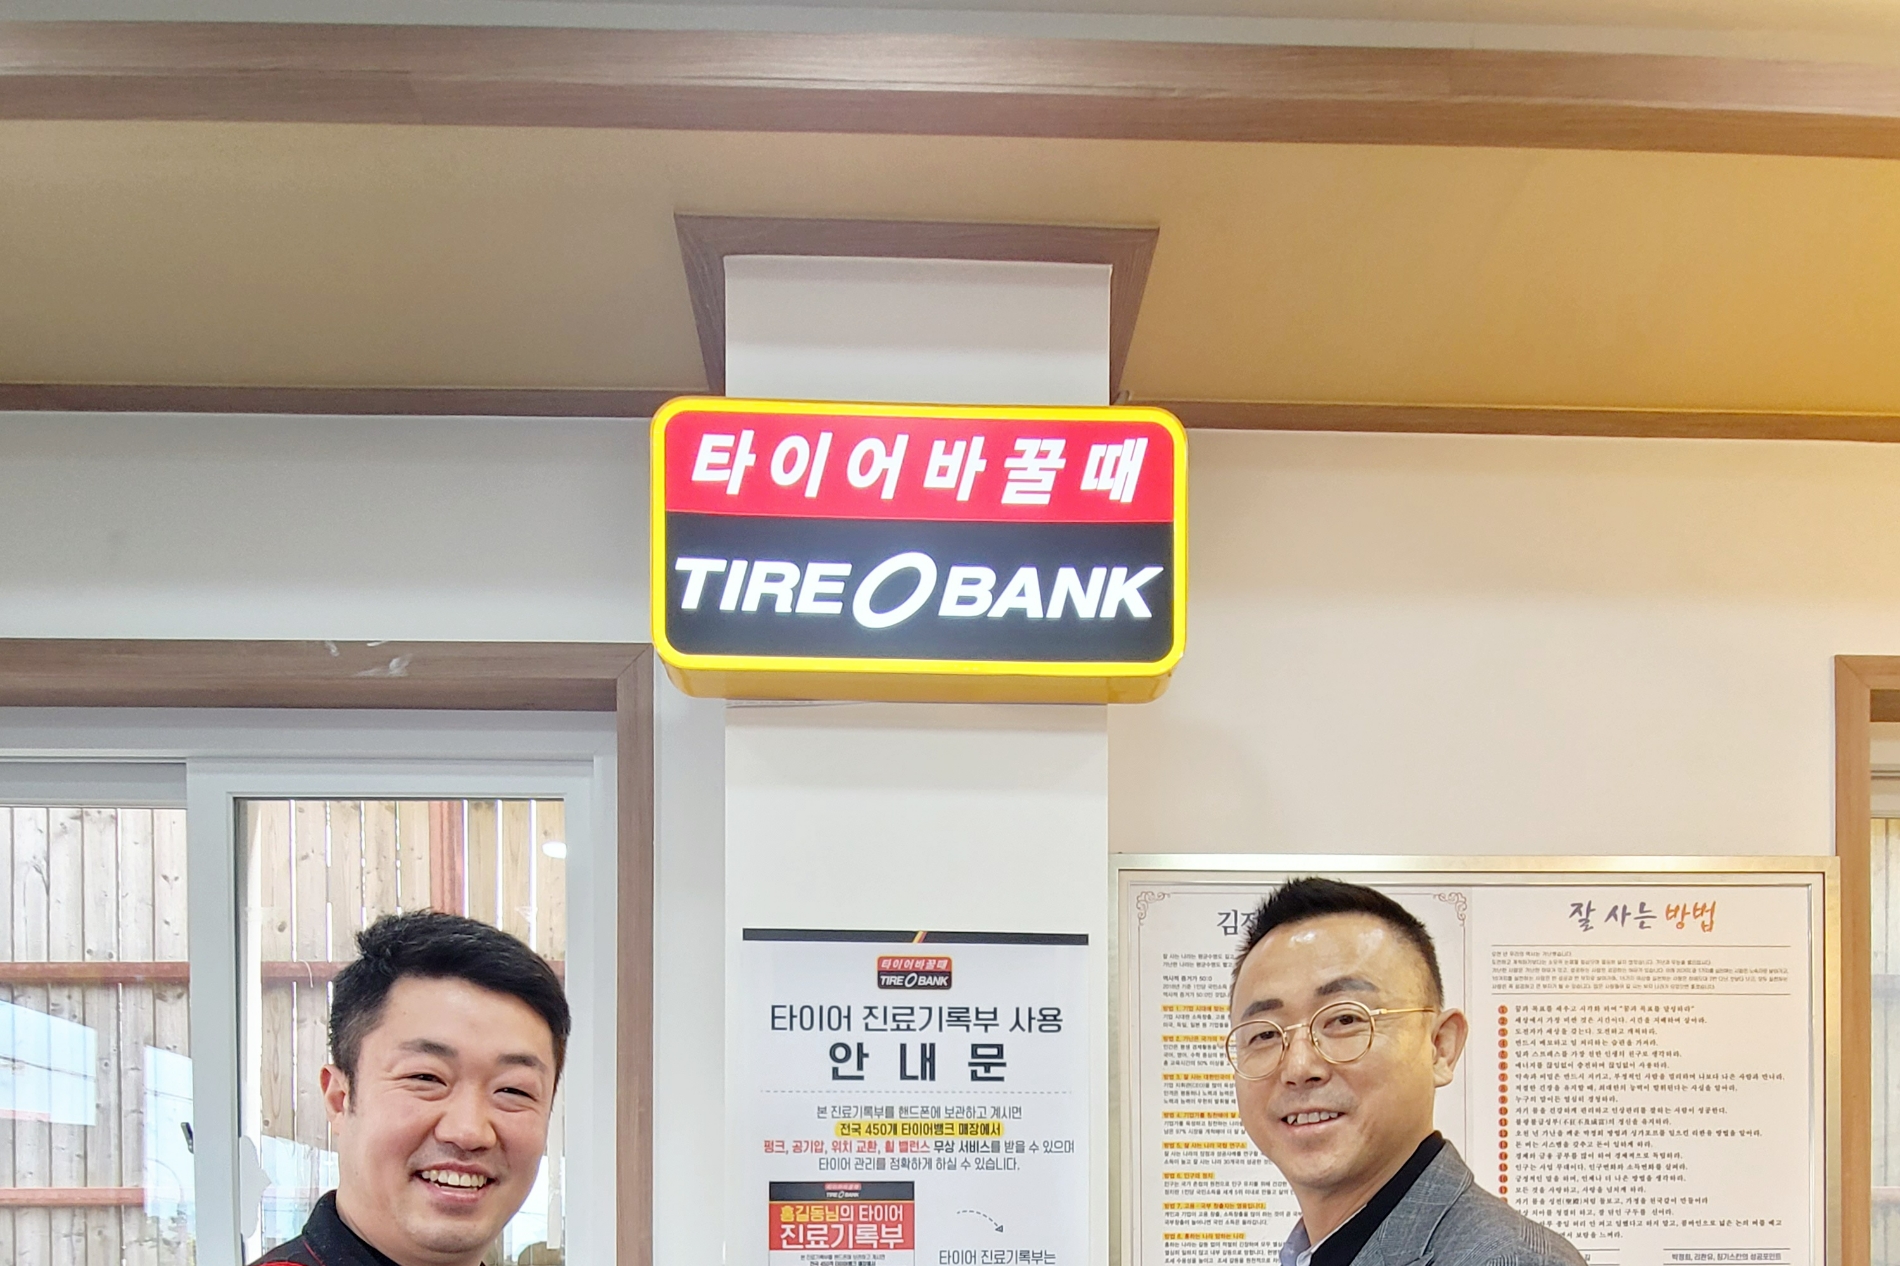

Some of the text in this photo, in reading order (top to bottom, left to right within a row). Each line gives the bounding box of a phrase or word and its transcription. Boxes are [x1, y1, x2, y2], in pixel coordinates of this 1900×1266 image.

[1569, 900, 1716, 932] 잘 사는 방법
[772, 1005, 1063, 1033] 타이어 진료기록부 사용
[832, 1106, 894, 1119] 진료기록부를
[899, 1106, 940, 1119] 핸드폰에
[945, 1106, 986, 1119] 보관하고
[990, 1106, 1021, 1119] 계시면
[841, 1123, 1000, 1135] 전국 450개 타이어뱅크 매장에서
[764, 1140, 788, 1154] 펑크,
[792, 1140, 827, 1154] 공기압,
[832, 1140, 852, 1153] 위치
[856, 1140, 880, 1154] 교환,
[934, 1140, 955, 1153] 무상
[958, 1140, 1000, 1153] 서비스를
[1004, 1140, 1025, 1153] 받을
[1029, 1140, 1039, 1153] 수
[1043, 1140, 1074, 1153] 있으며
[819, 1157, 1020, 1170] 타이어 관리를 정확하게 하실 수 있습니다.
[781, 1203, 903, 1222] 홍길동님의 타이어
[781, 1224, 904, 1249] 진료기록부
[940, 1250, 1056, 1265] 타이어 진료기록부는
